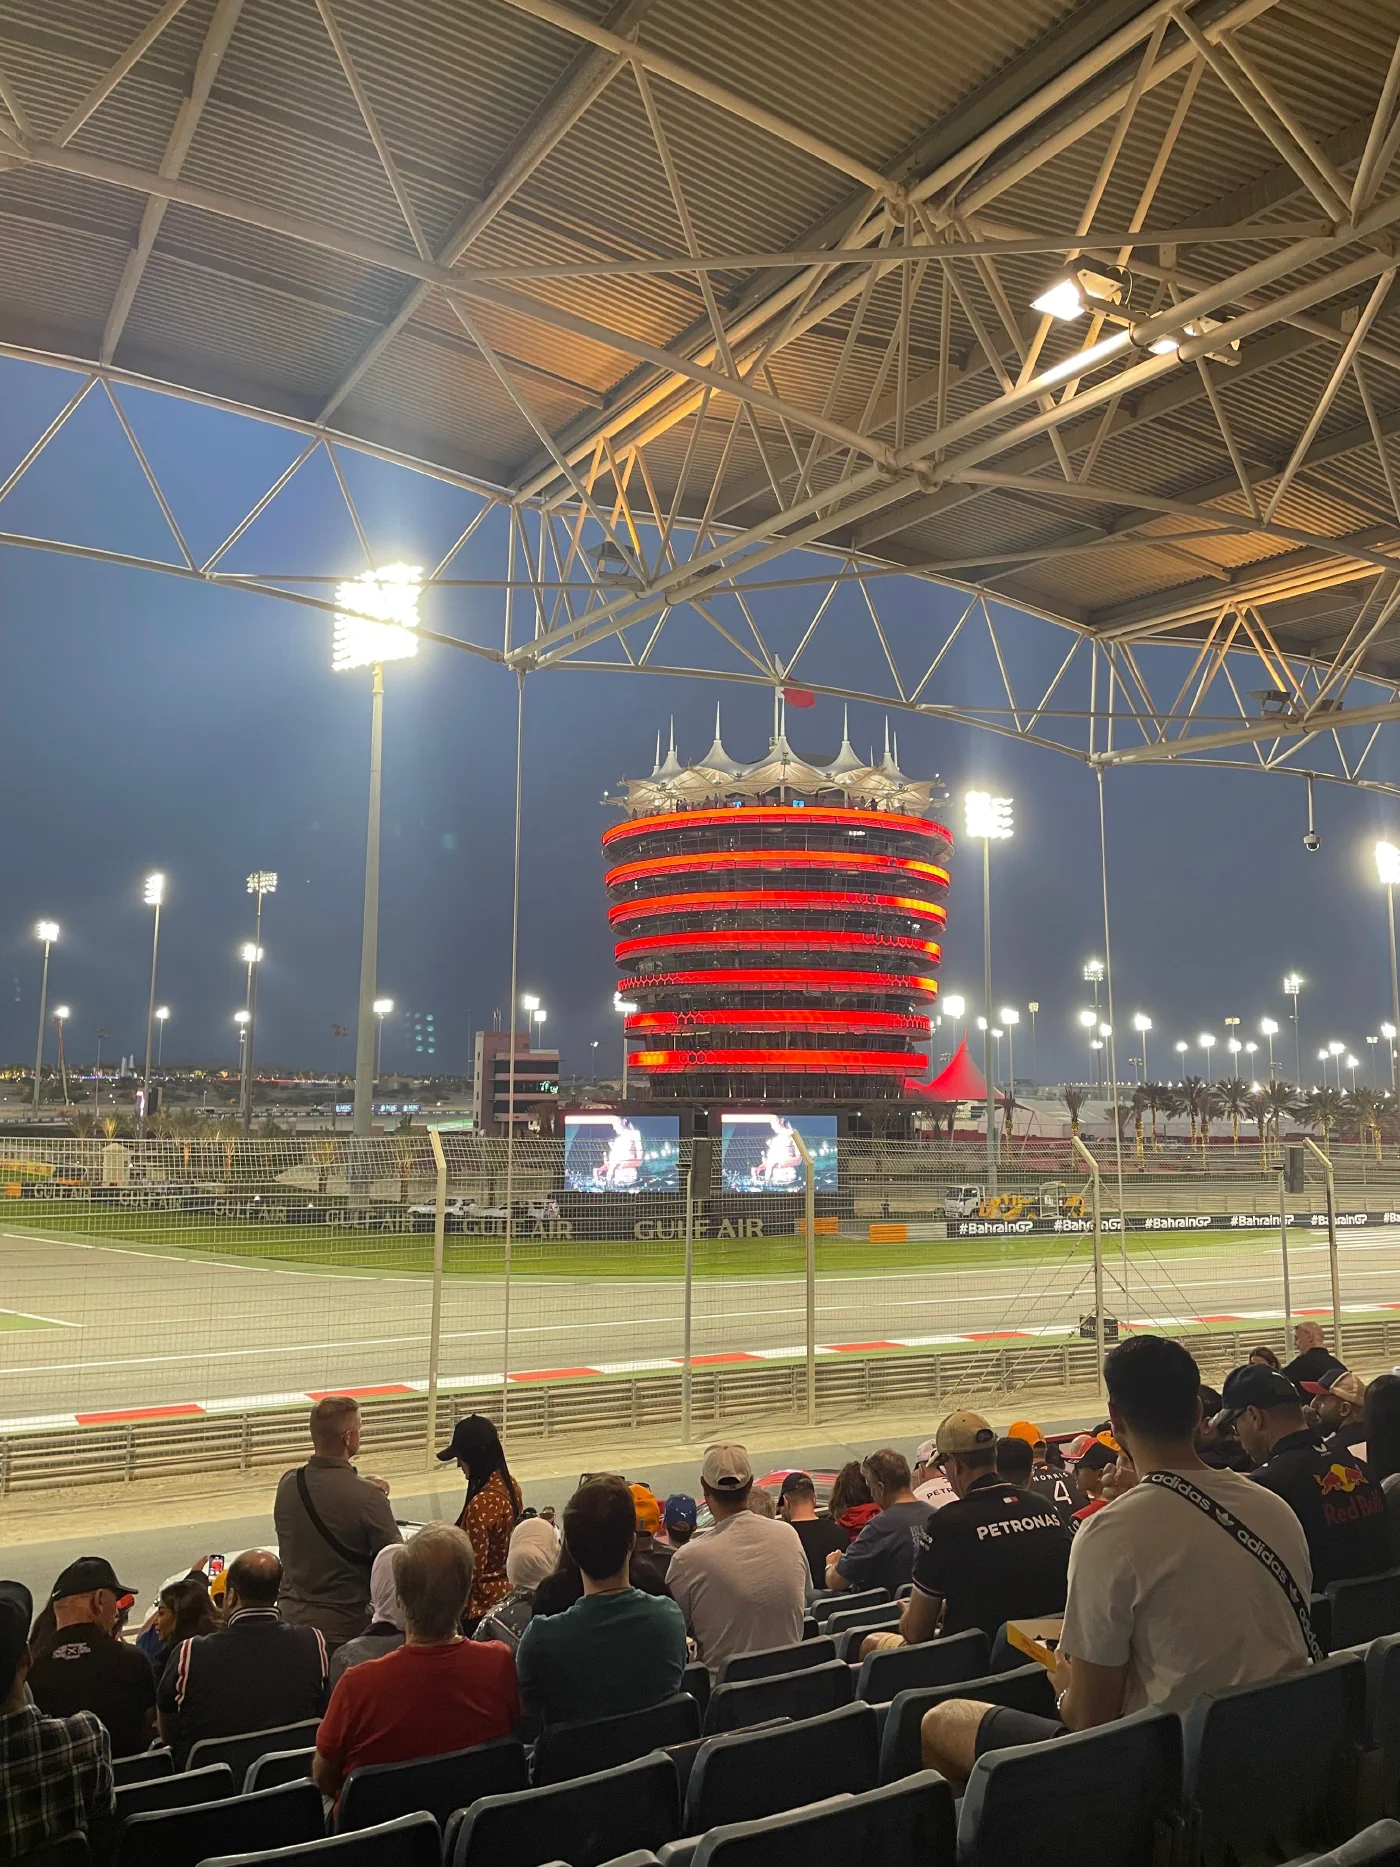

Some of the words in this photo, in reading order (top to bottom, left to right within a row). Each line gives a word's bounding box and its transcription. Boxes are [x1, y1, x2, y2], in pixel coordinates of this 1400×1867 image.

[381, 1210, 414, 1233] AIR
[634, 1219, 709, 1240] GULF
[717, 1218, 764, 1238] AIR
[959, 1220, 1034, 1234] #BahrainGP
[1145, 1216, 1212, 1229] #BahrainGP
[1032, 1471, 1069, 1482] NORRIS
[1053, 1480, 1072, 1505] 4
[1151, 1472, 1211, 1511] adidas
[976, 1513, 1061, 1541] PETRONAS
[1236, 1529, 1287, 1584] adidas
